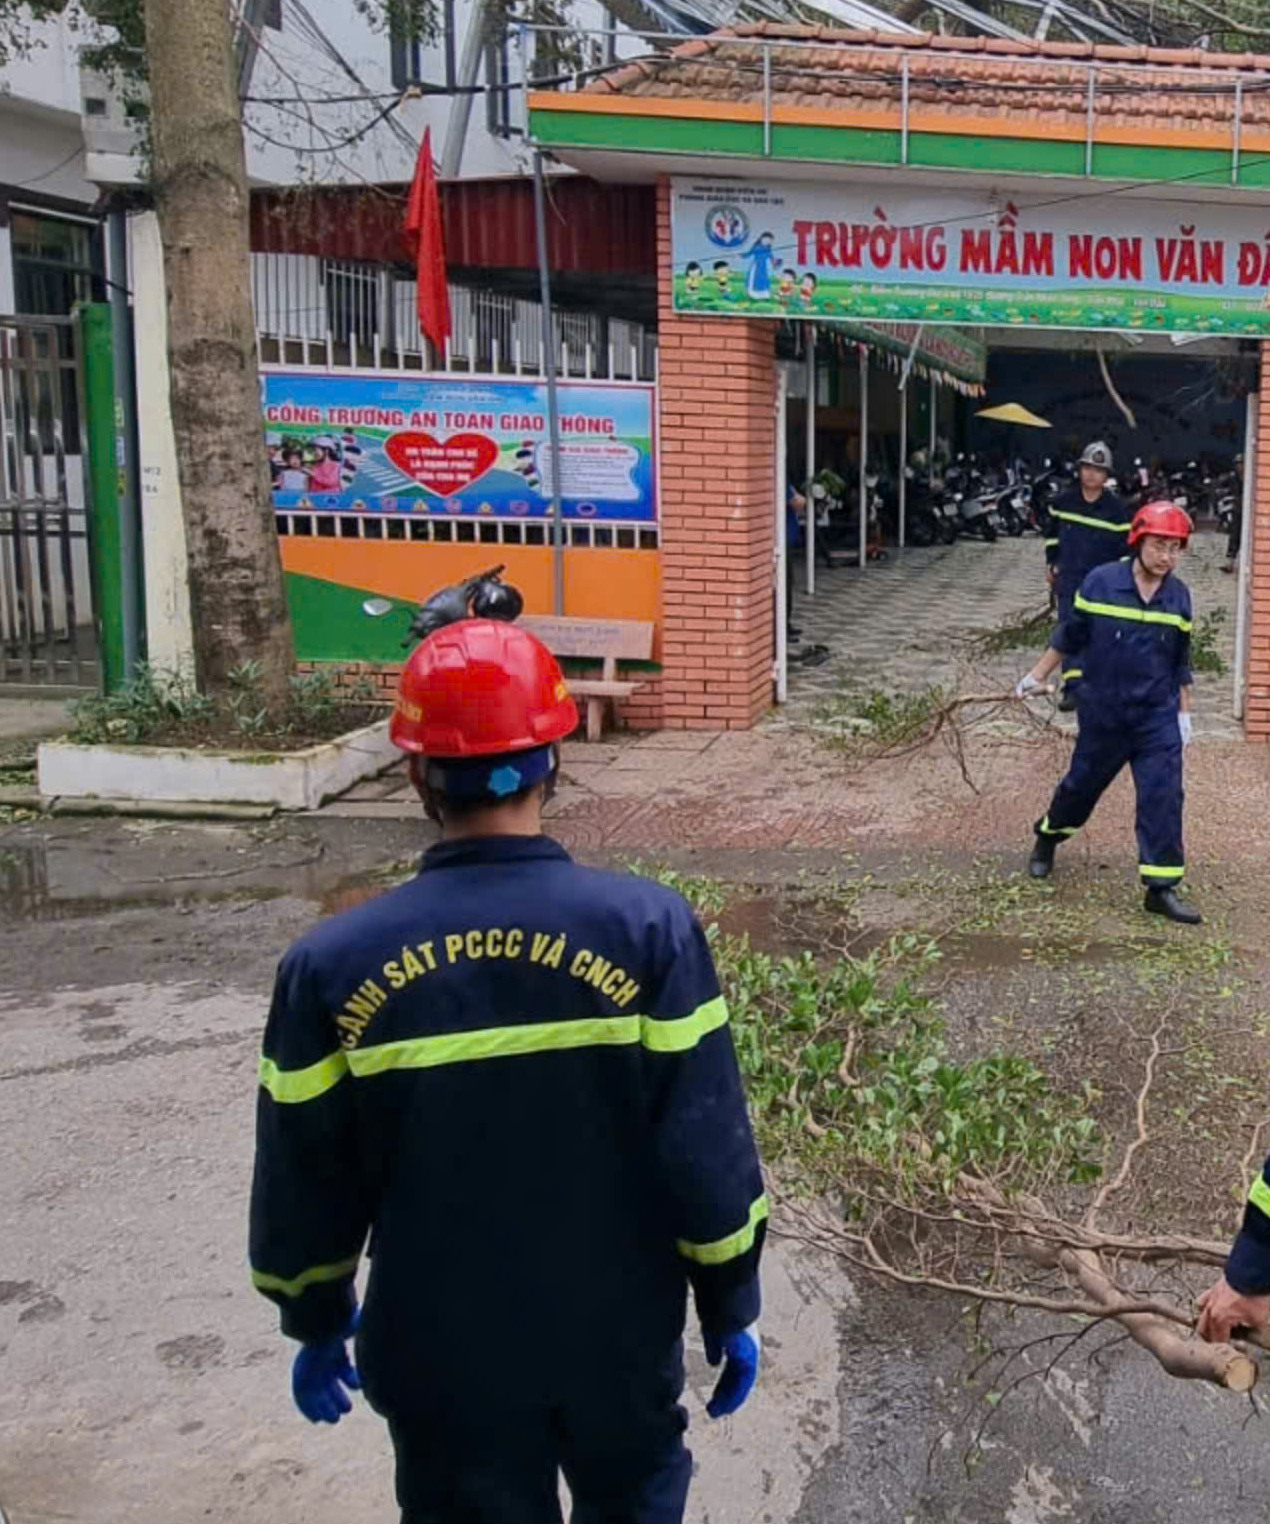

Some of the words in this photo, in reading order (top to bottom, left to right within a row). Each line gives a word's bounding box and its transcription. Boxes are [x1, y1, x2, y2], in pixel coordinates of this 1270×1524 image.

[792, 205, 947, 272] TRƯỜNG
[959, 200, 1055, 276] MẦM
[1068, 234, 1142, 281] NON
[1155, 224, 1224, 285] VĂN
[410, 411, 437, 427] AN
[500, 414, 545, 431] GIAO
[382, 940, 438, 990] SÁT
[445, 928, 524, 964] PCCC
[529, 931, 567, 970] VÀ
[569, 948, 641, 1008] CNCH
